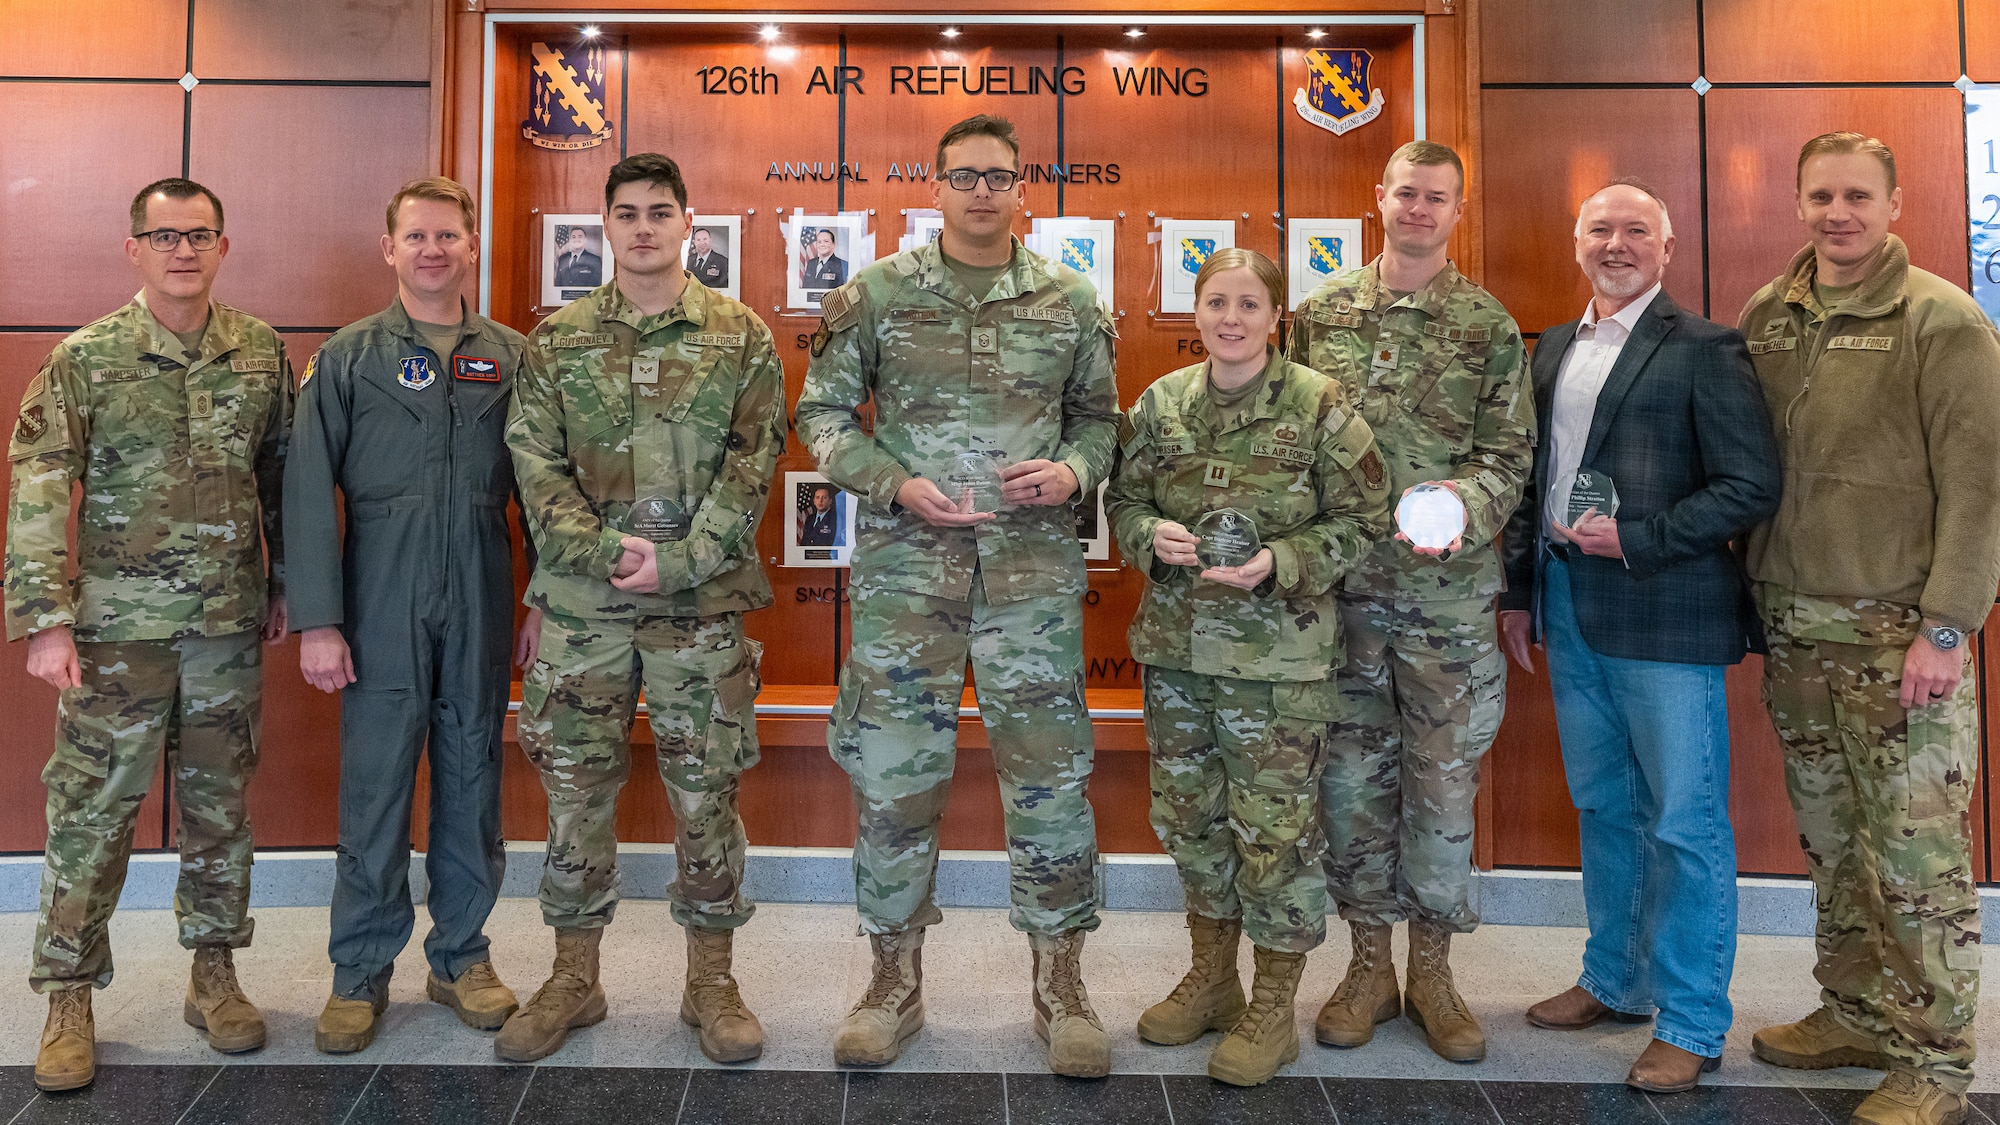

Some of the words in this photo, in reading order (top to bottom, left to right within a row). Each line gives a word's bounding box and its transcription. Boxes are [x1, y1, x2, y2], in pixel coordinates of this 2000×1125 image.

[695, 65, 778, 96] 126th
[805, 65, 863, 96] AIR
[890, 66, 1086, 96] REFUELING
[1113, 66, 1209, 97] WING
[1311, 113, 1323, 124] AIR
[1323, 115, 1360, 133] REFUELING
[1360, 104, 1378, 121] WING
[766, 161, 869, 183] ANNUAL
[886, 162, 937, 183] AW
[1016, 307, 1028, 318] US
[1030, 308, 1045, 320] AIR
[1046, 309, 1069, 322] FORCE
[686, 332, 698, 343] US
[700, 334, 714, 345] AIR
[716, 335, 741, 346] FORCE
[1833, 337, 1847, 347] U.S.
[1850, 337, 1863, 348] AIR
[1865, 338, 1889, 349] FORCE
[1253, 445, 1269, 456] U.S.
[1272, 447, 1286, 458] AIR
[1288, 449, 1314, 463] FORCE
